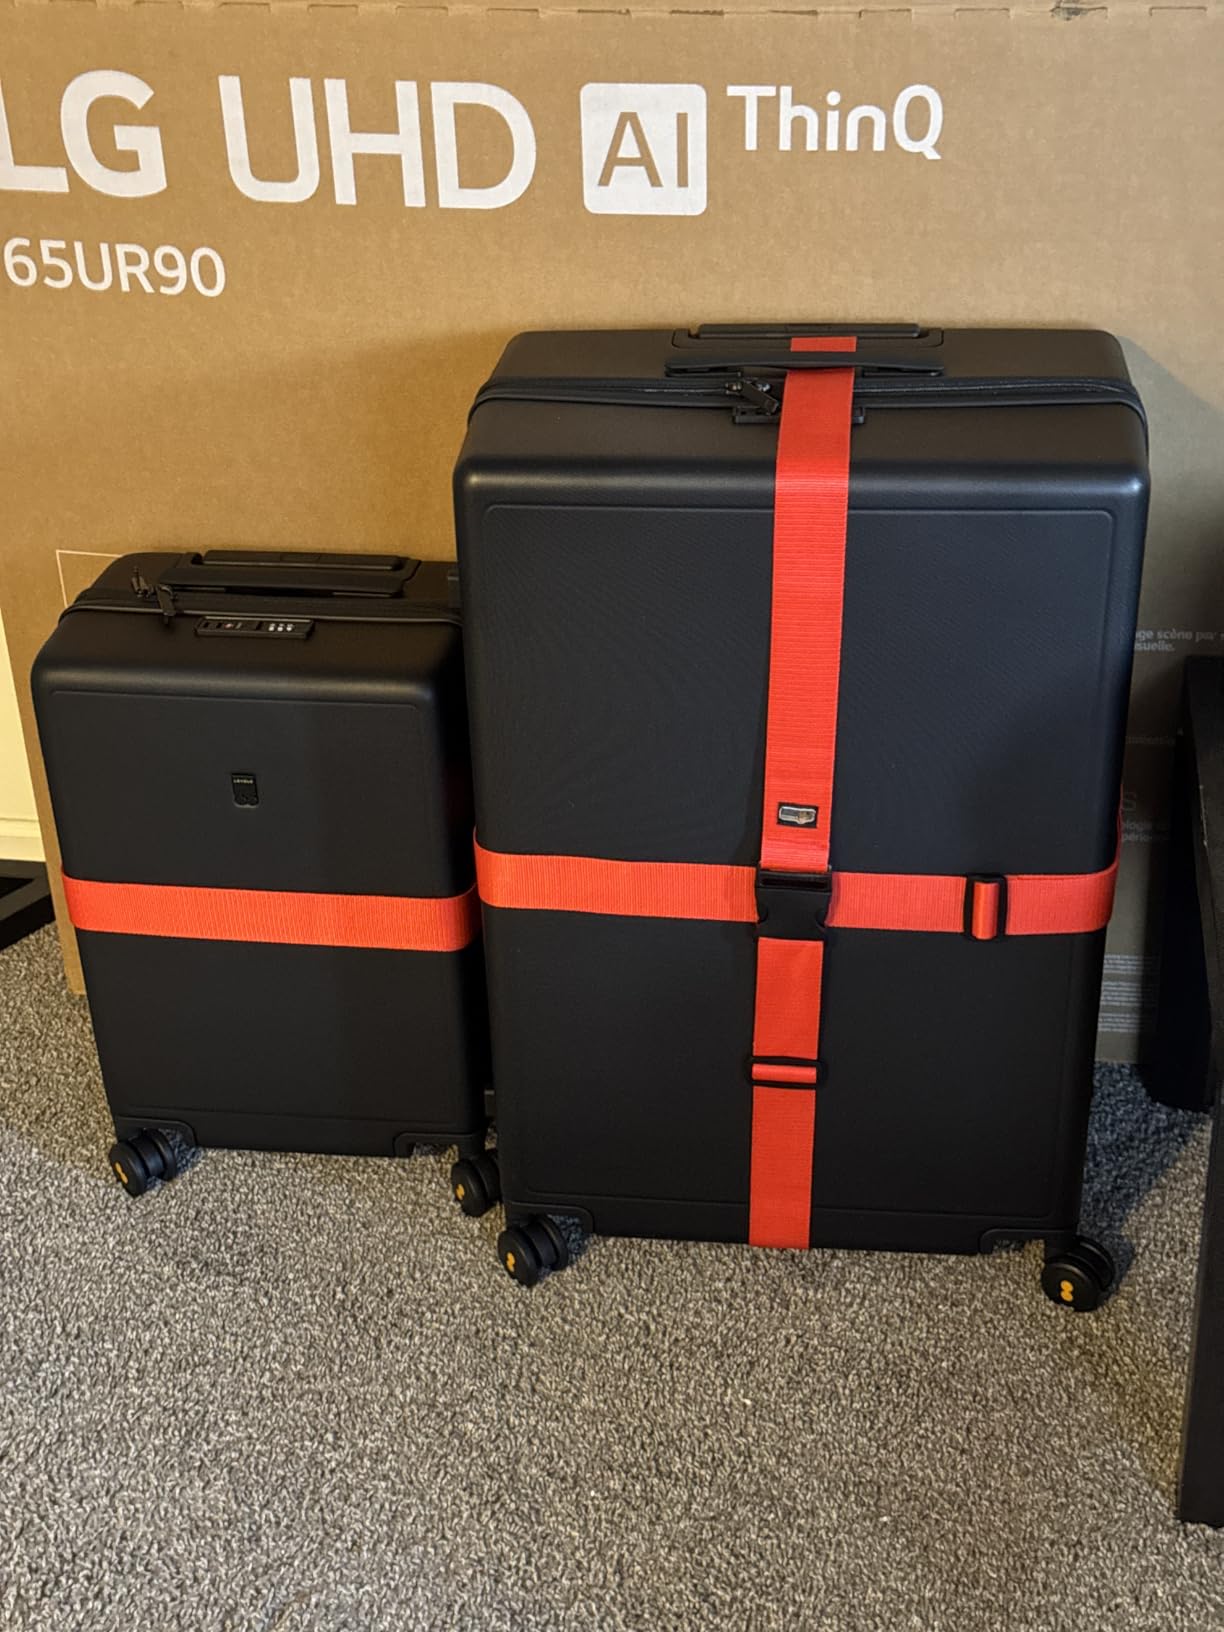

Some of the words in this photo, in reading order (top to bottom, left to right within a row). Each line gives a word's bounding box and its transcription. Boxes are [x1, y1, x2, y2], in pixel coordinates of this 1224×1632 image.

[0, 70, 168, 198] LG
[218, 75, 537, 210] UHD
[597, 111, 689, 188] AI
[726, 84, 943, 160] ThinQ
[4, 237, 226, 297] 65UR90
